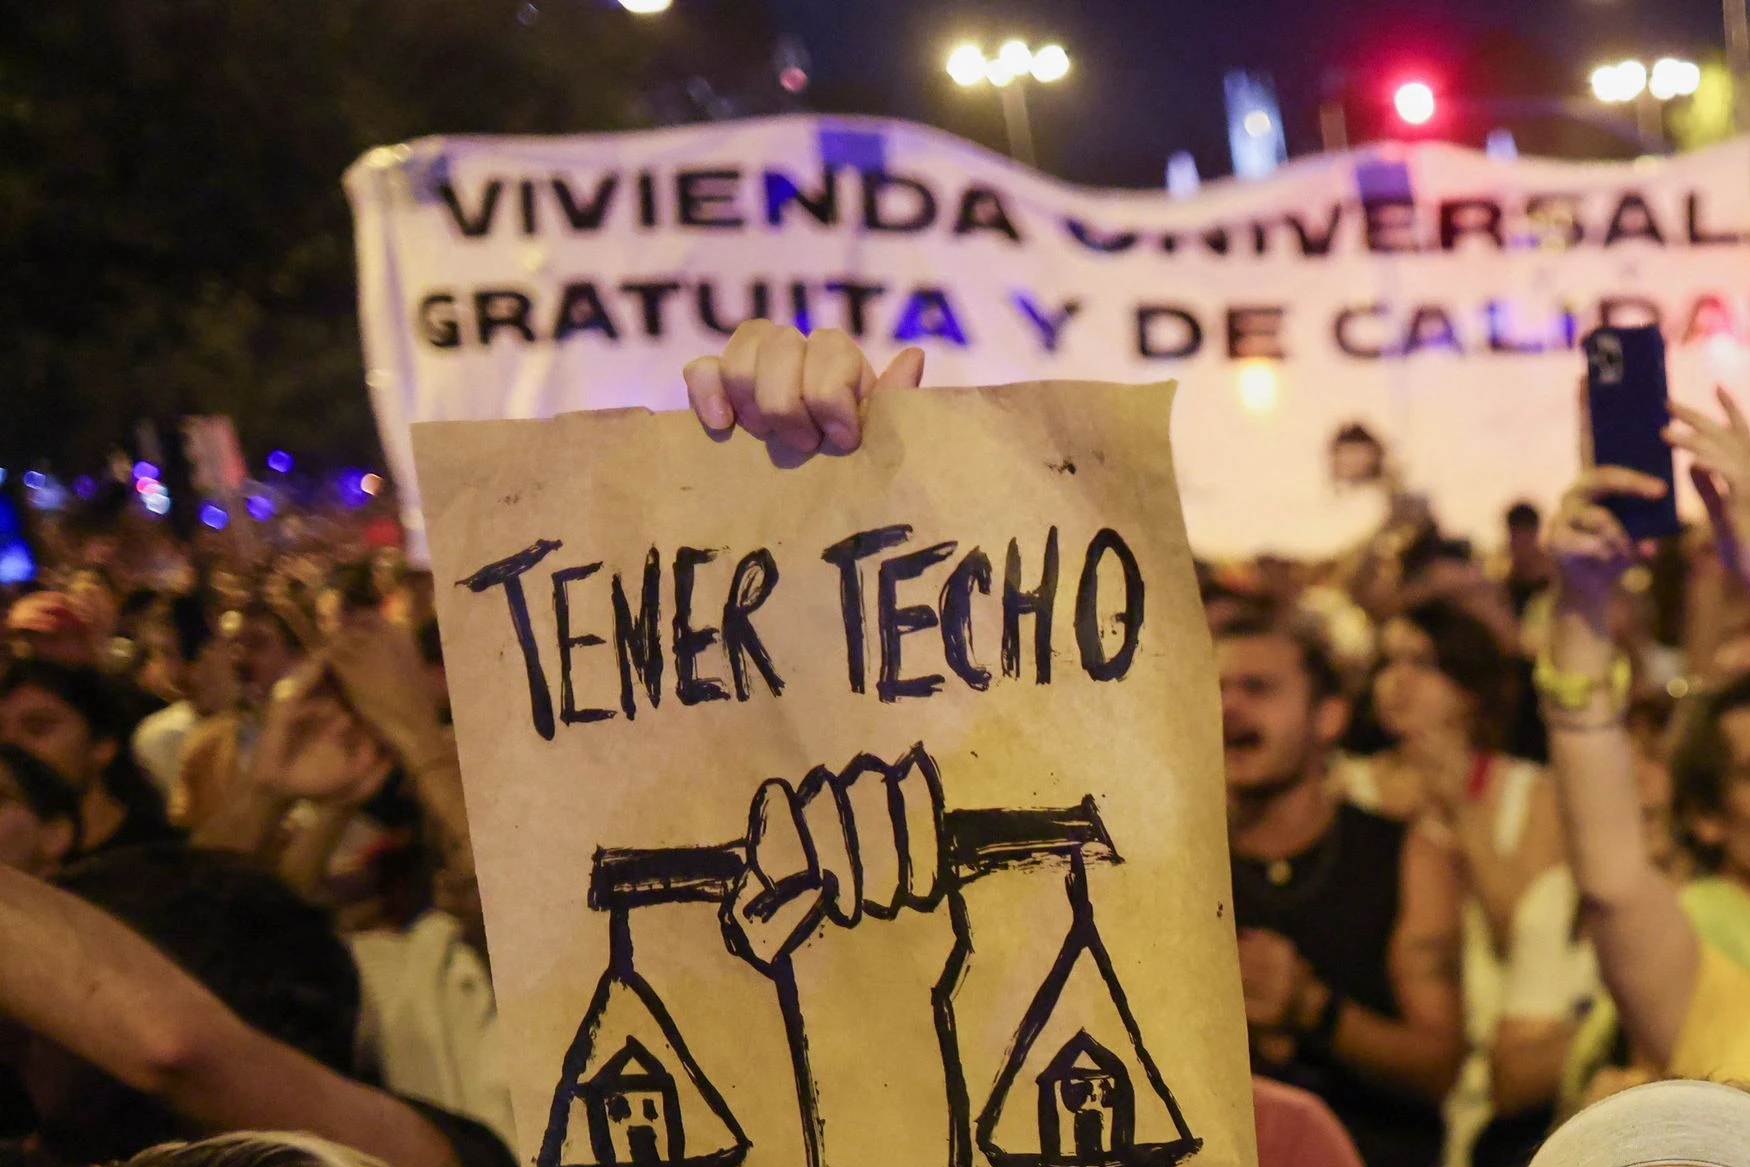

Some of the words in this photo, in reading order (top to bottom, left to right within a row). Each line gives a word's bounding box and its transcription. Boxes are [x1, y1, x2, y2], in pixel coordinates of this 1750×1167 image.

[436, 162, 1022, 240] VIVIENDA
[418, 278, 966, 348] GRATUITA
[1012, 286, 1079, 352] Y
[1135, 303, 1288, 360] DE
[454, 538, 787, 741] TENER
[820, 523, 1146, 704] TECHO
